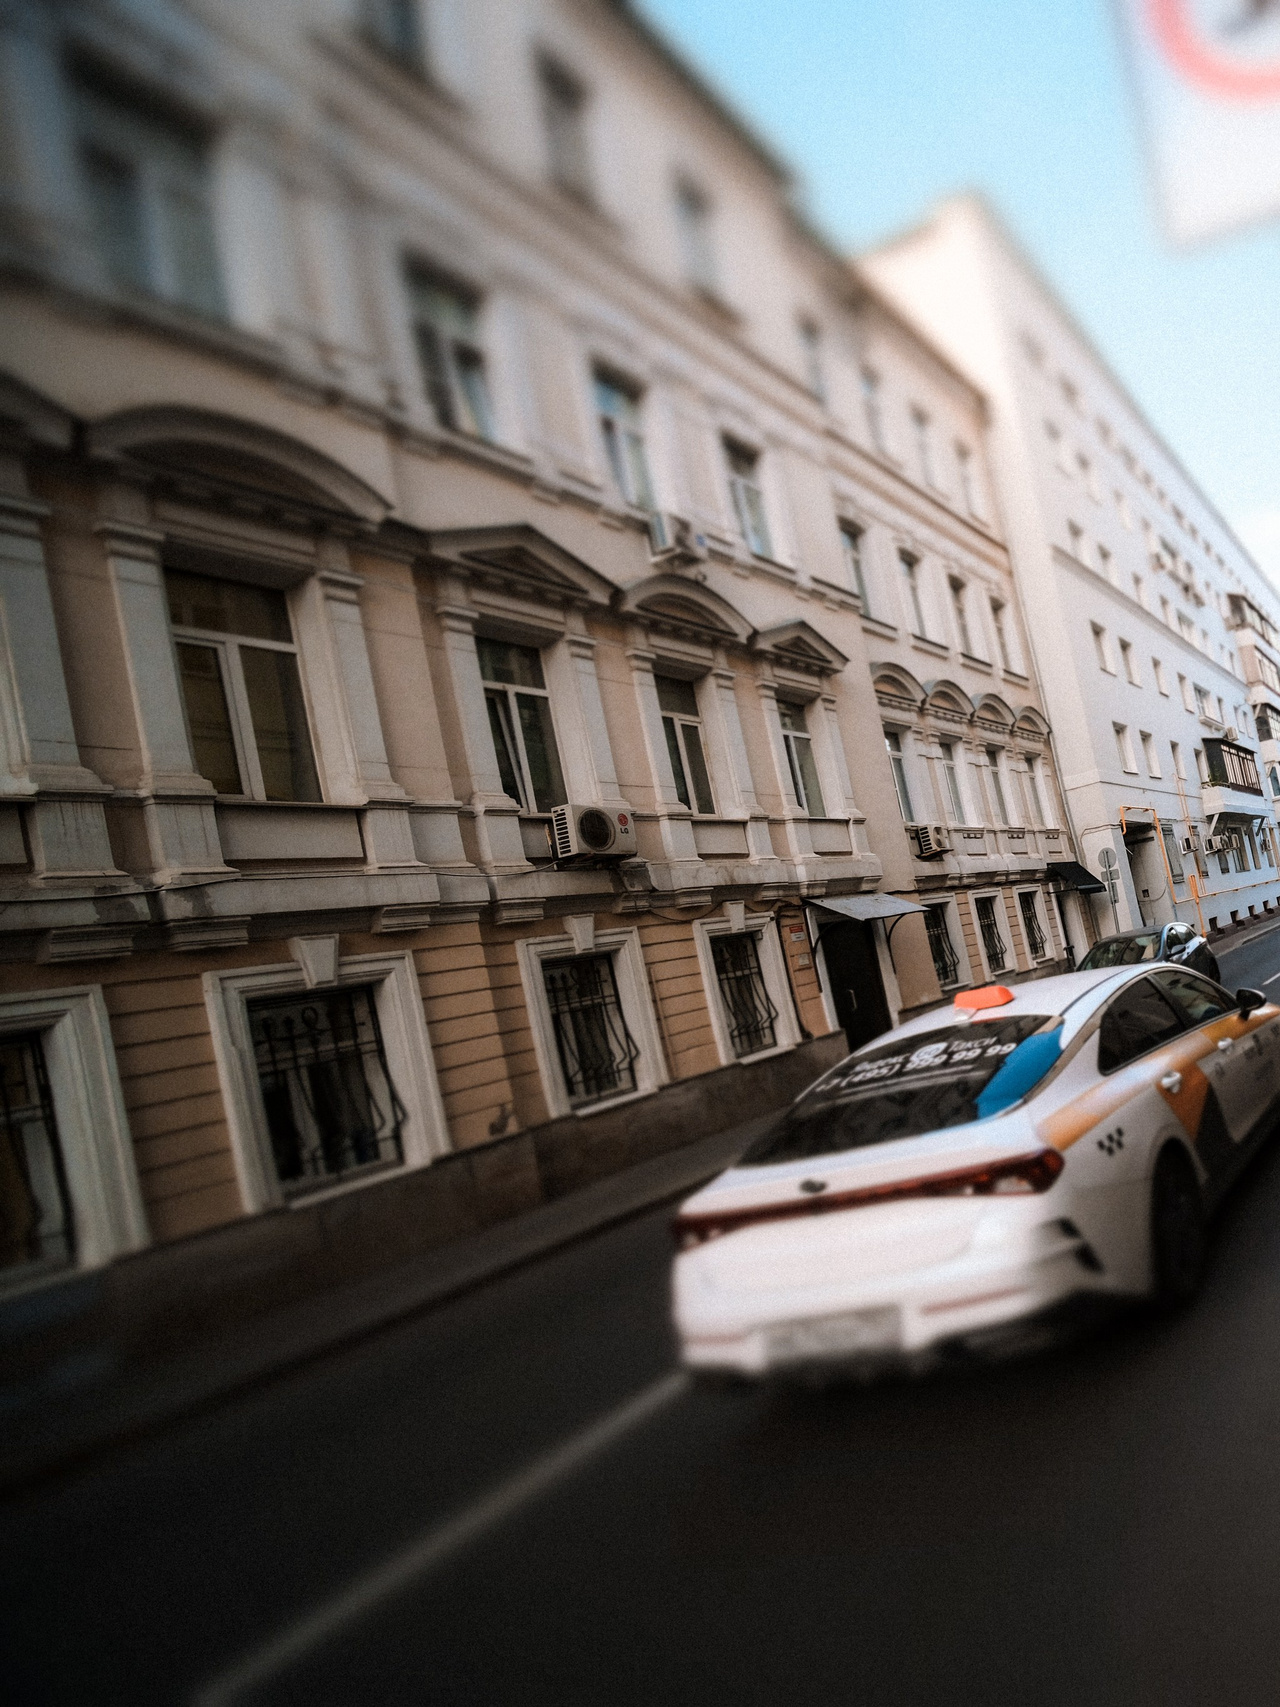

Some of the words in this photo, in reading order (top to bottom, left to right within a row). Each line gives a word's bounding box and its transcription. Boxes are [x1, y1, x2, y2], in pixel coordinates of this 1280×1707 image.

[619, 827, 630, 835] LG
[948, 1036, 998, 1053] Такси
[840, 1064, 901, 1088] (495)
[902, 1054, 948, 1072] 999
[949, 1048, 982, 1062] 99
[984, 1043, 1017, 1057] 99
